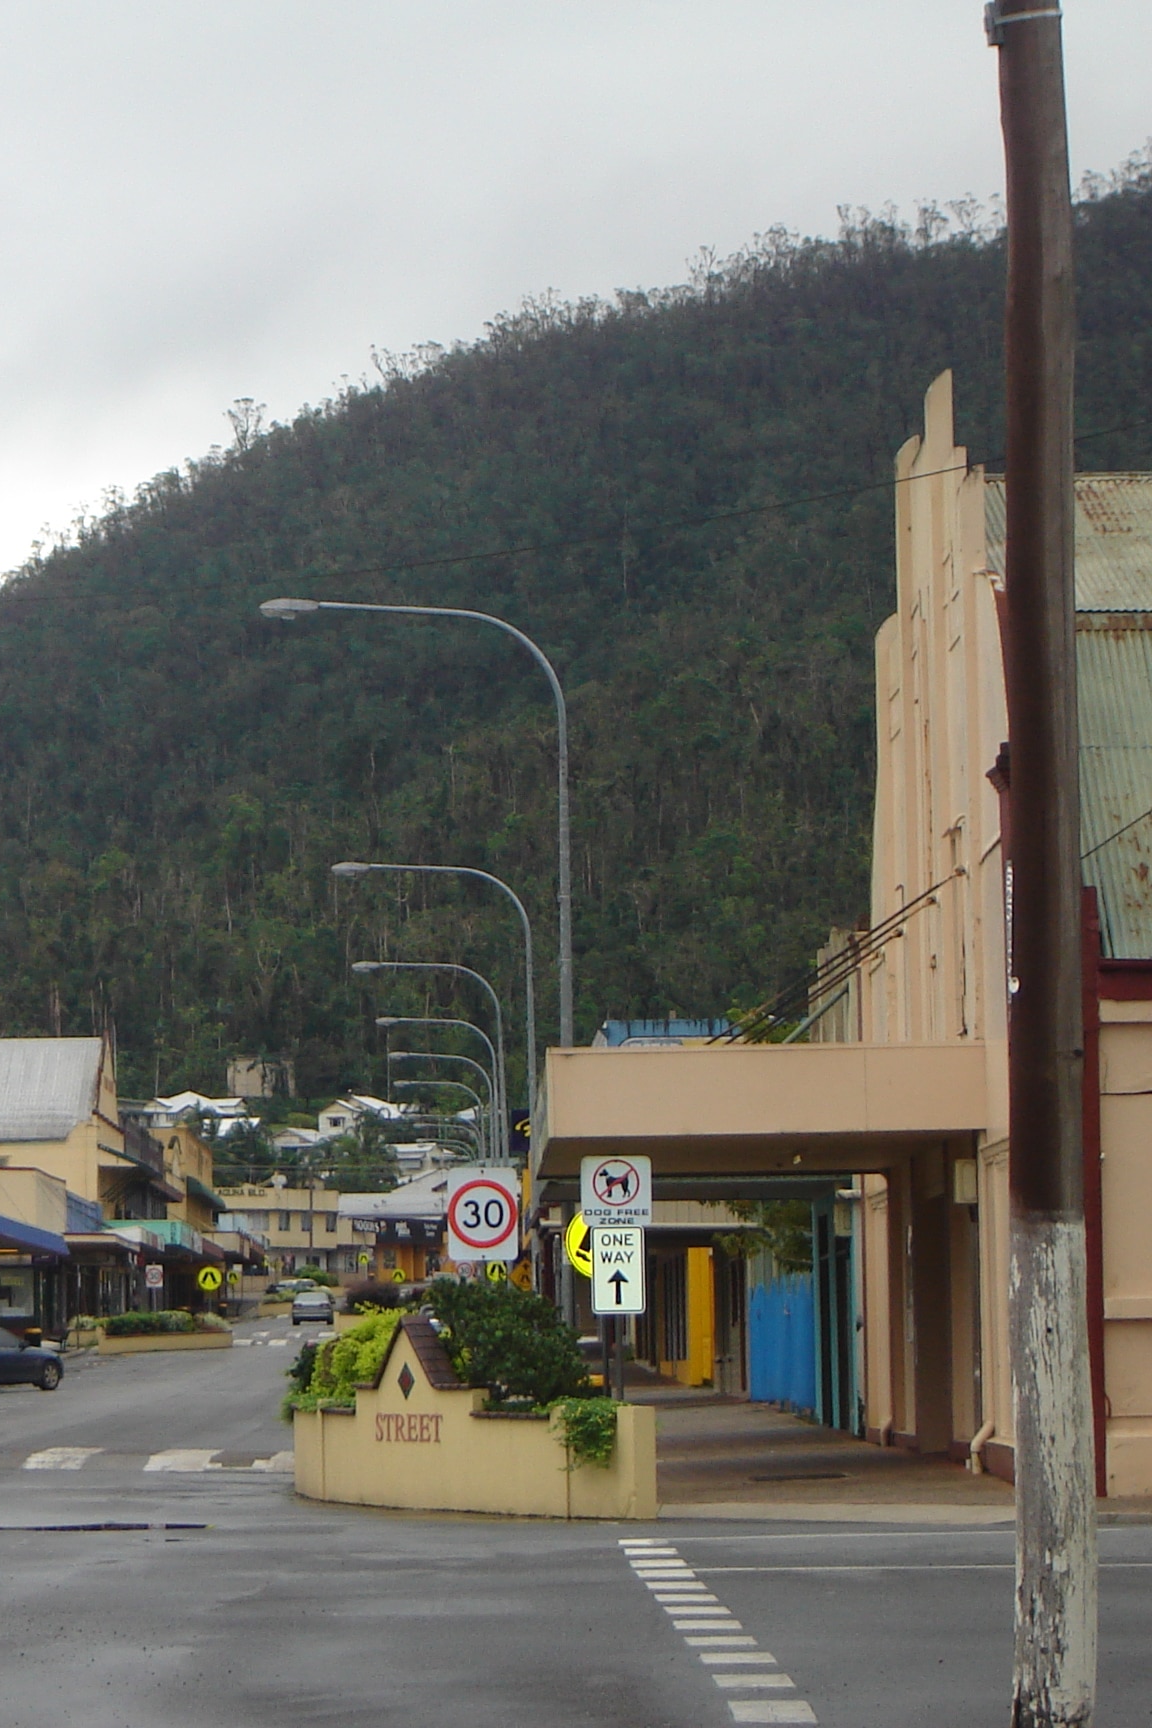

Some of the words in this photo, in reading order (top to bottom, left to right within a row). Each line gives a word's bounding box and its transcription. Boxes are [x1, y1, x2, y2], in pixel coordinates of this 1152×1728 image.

[463, 1199, 505, 1229] 30
[584, 1208, 612, 1216] DOG
[616, 1208, 649, 1216] FREE
[599, 1217, 635, 1225] ZONE
[601, 1234, 634, 1247] ONE
[600, 1251, 635, 1264] WAY
[375, 1412, 443, 1443] STREET
